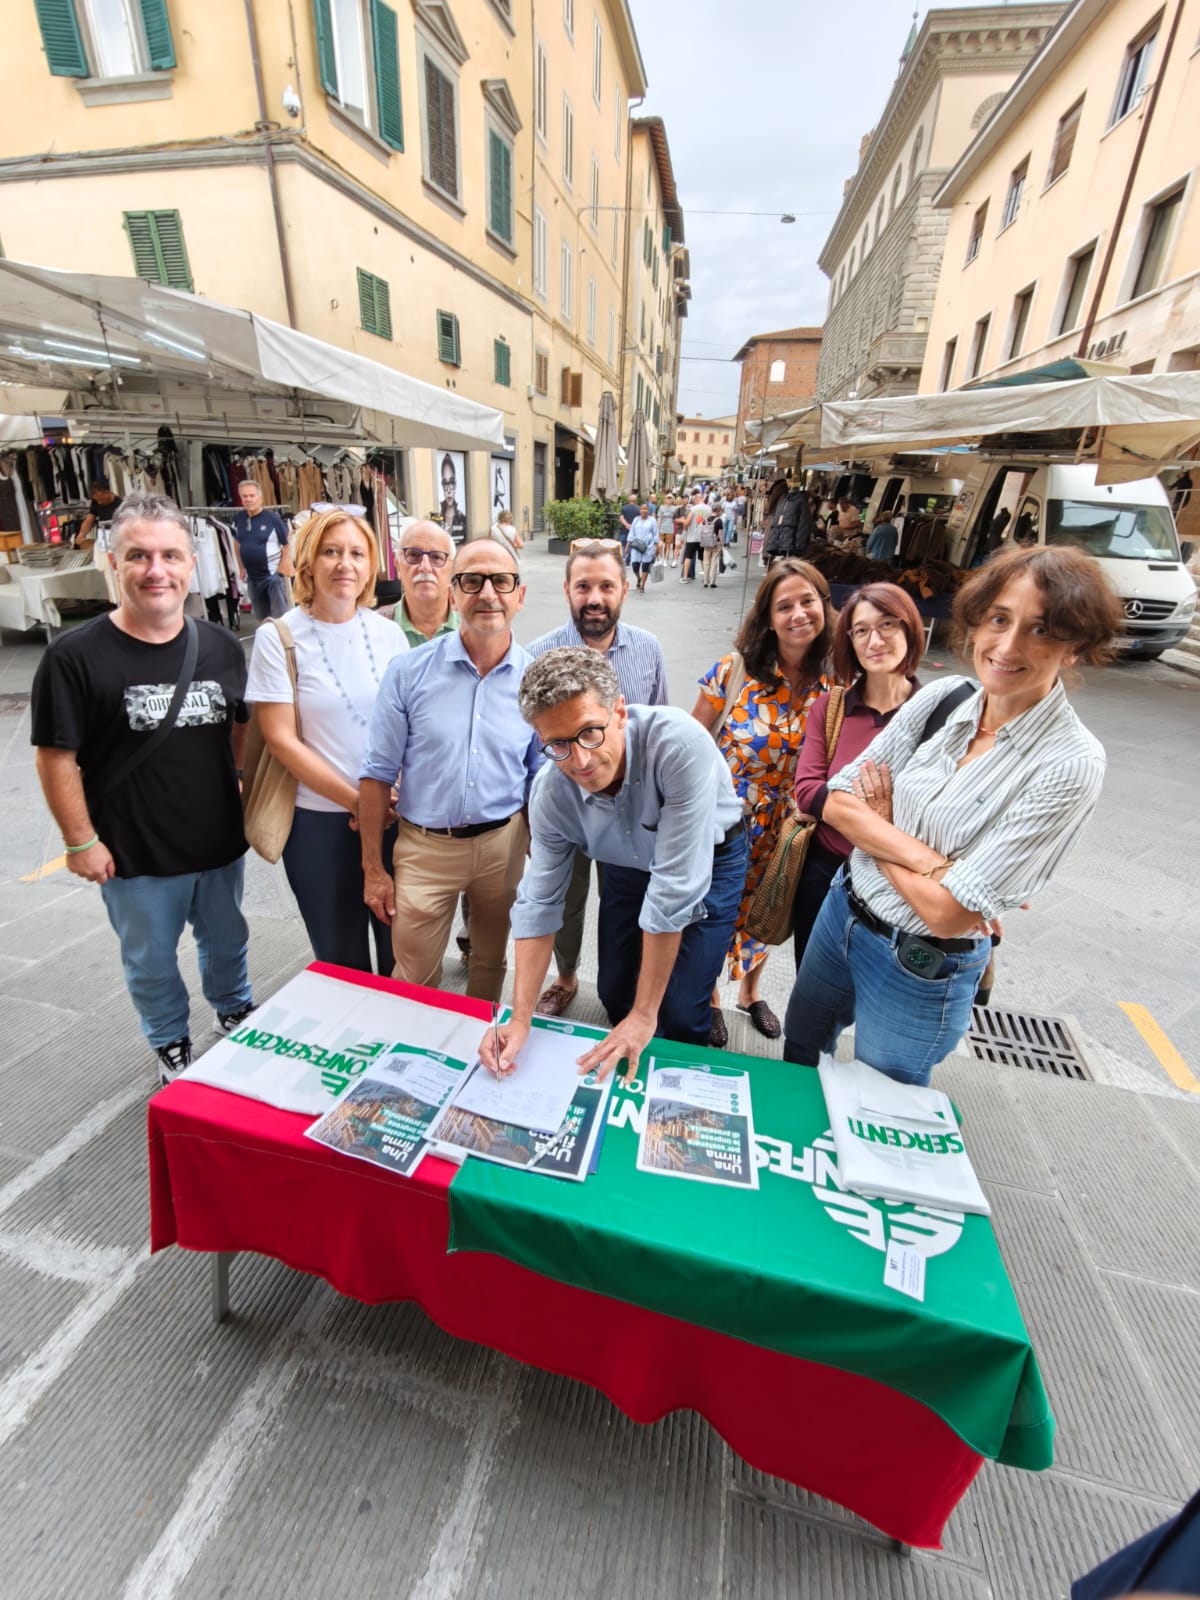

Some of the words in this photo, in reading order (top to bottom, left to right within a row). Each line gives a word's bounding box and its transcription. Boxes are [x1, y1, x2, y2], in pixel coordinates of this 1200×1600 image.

[148, 694, 208, 711] ORINAL
[227, 1027, 368, 1076] ONFESERCENT
[381, 1134, 415, 1152] firma
[382, 1145, 408, 1163] Una
[706, 1149, 742, 1166] firma
[714, 1159, 743, 1176] Una
